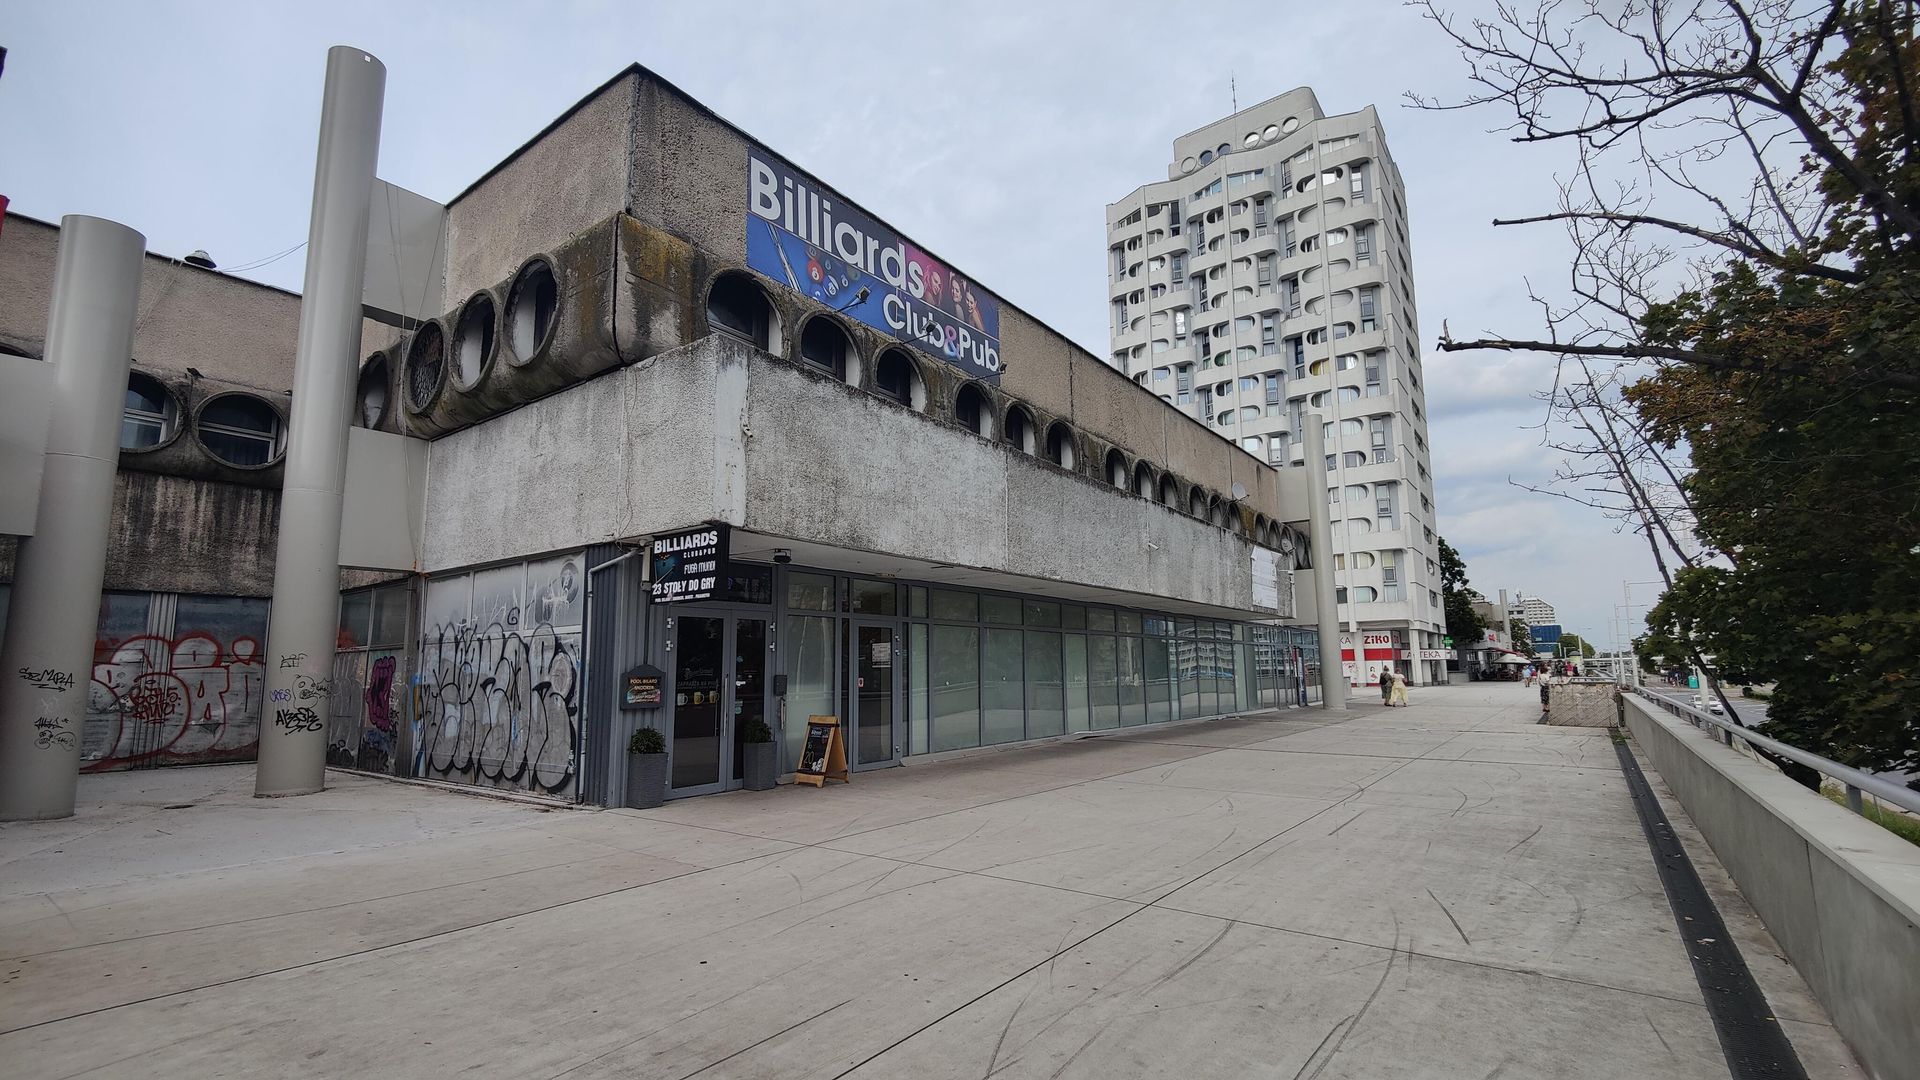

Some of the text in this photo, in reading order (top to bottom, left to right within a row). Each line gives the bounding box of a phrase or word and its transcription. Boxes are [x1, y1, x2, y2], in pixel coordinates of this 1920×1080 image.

[751, 156, 925, 299] Billiards
[883, 294, 999, 372] Club&Pub
[654, 530, 718, 554] BILLIARDS
[652, 583, 662, 595] 23
[688, 578, 699, 591] DO
[700, 577, 716, 590] GRY
[1406, 650, 1441, 659] ATEKA
